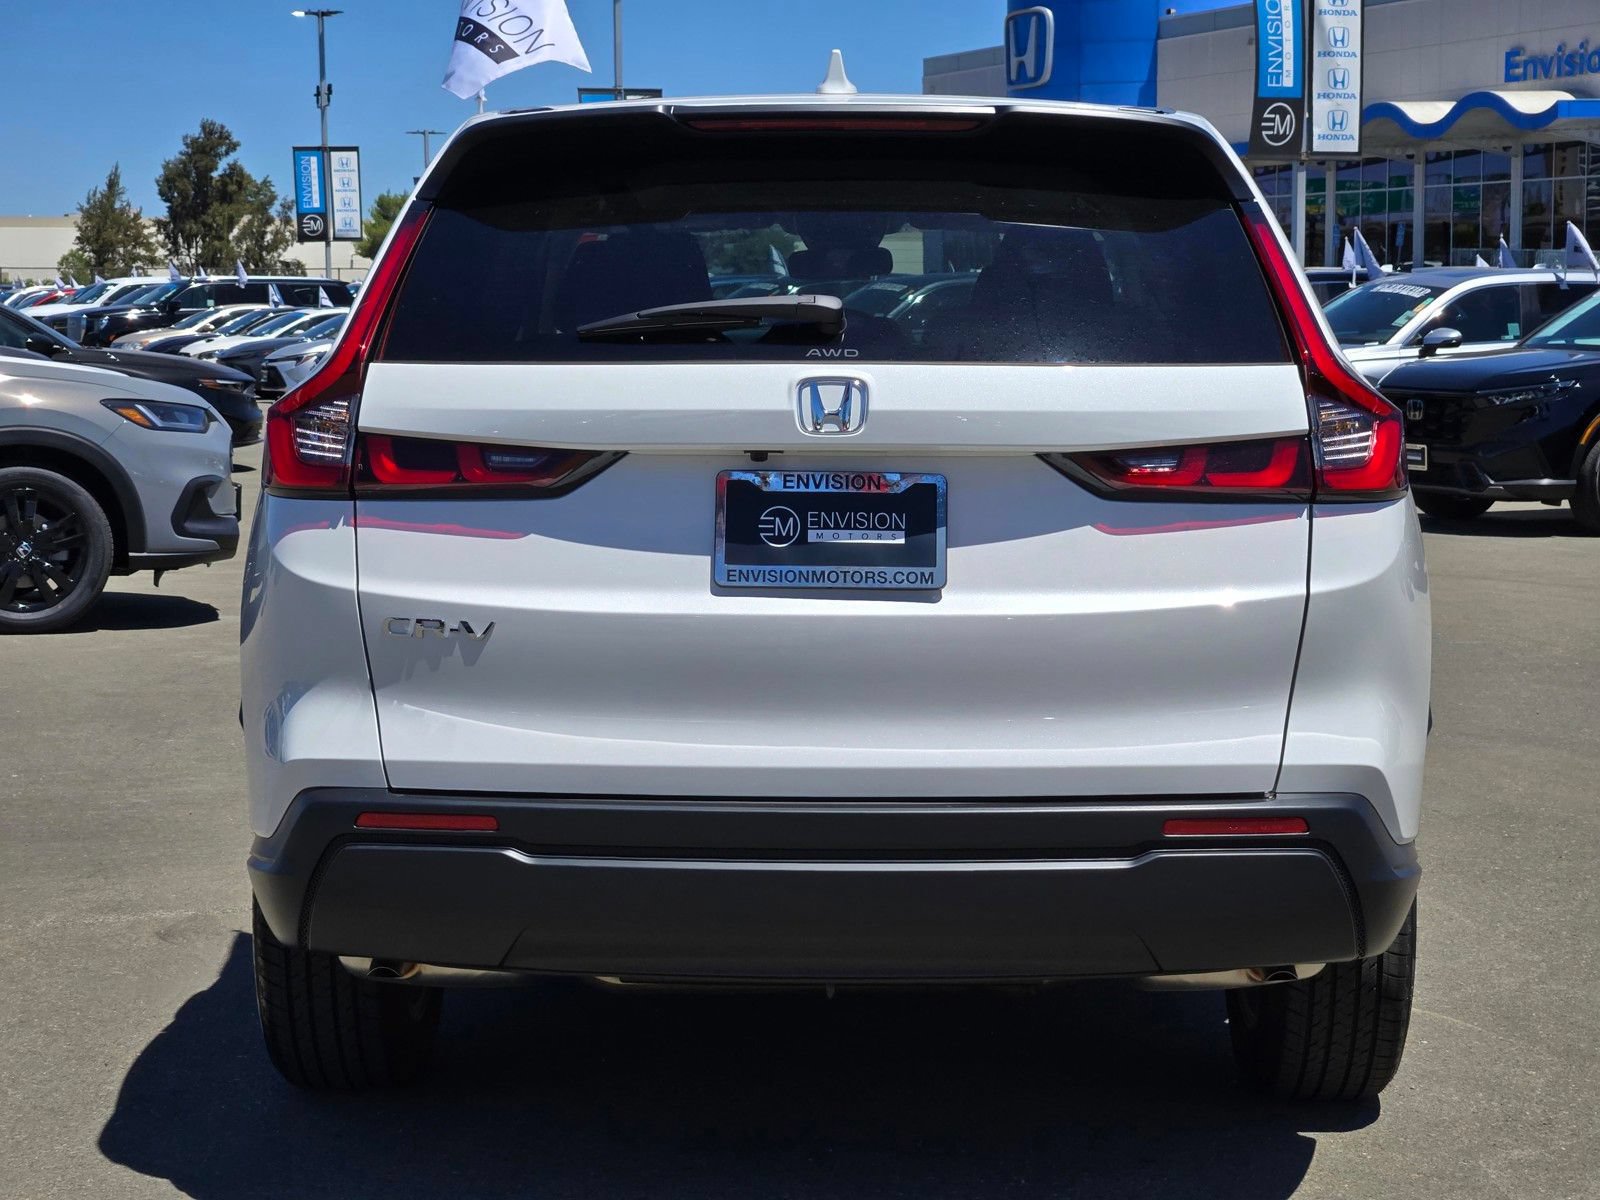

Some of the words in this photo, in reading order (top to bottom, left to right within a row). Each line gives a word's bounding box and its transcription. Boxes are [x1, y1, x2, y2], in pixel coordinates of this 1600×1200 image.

[1317, 92, 1357, 100] HONDA
[301, 156, 313, 209] ENVISION
[805, 348, 859, 357] AWD
[782, 473, 881, 490] ENVISION
[807, 511, 906, 530] ENVISION
[815, 532, 897, 541] MOTORS
[726, 569, 934, 585] ENVISIONMOTORS.COM
[384, 617, 496, 640] CR-V
